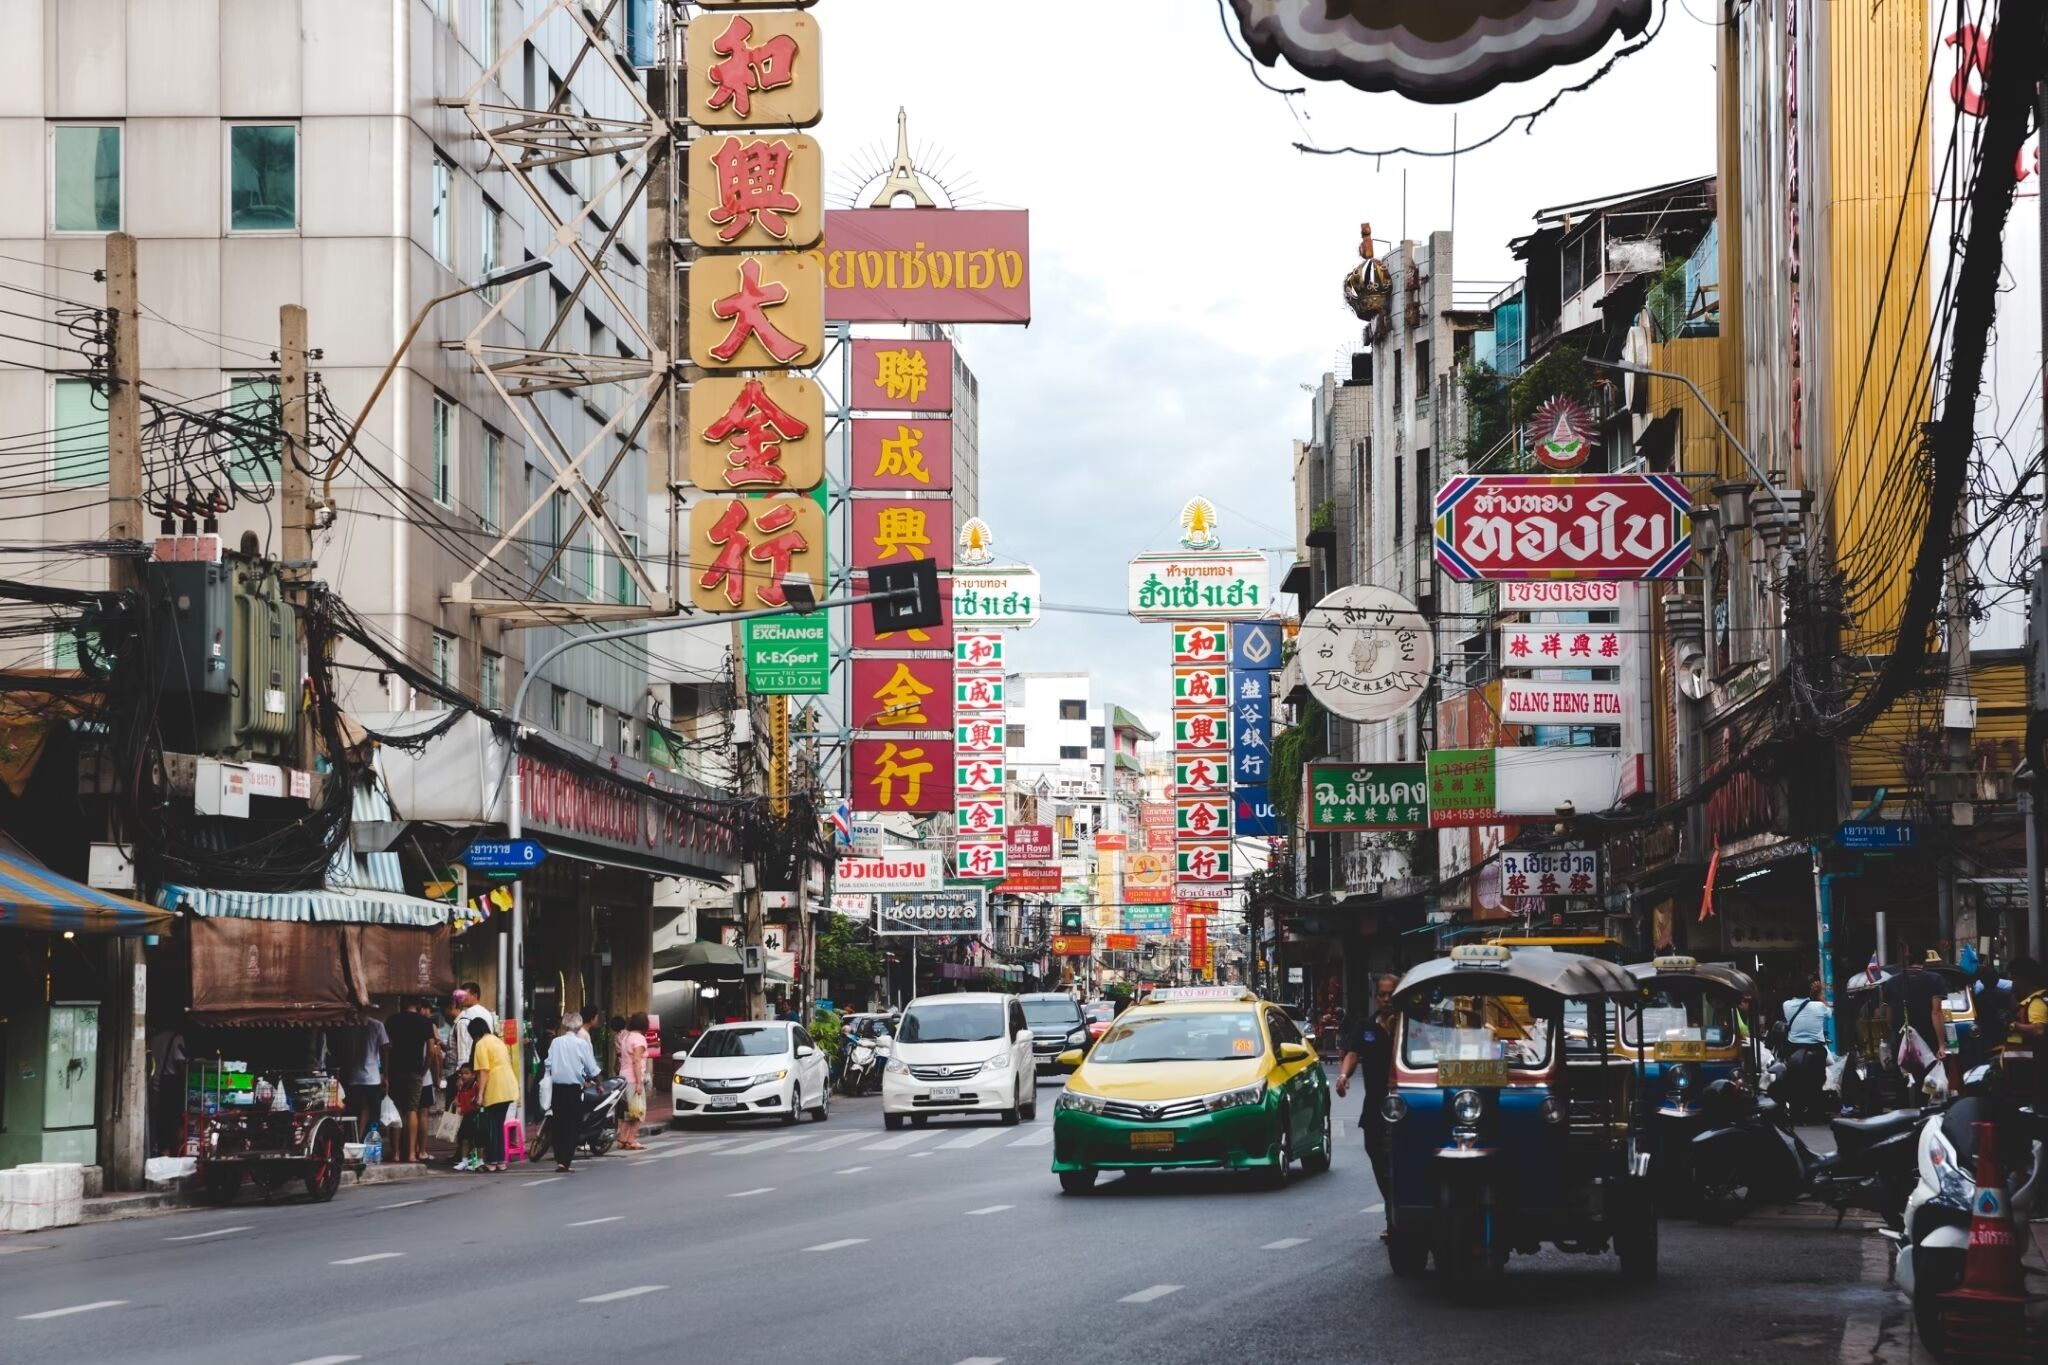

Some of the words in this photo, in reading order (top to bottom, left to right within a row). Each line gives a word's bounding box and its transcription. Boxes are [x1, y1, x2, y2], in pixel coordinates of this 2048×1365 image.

[1461, 492, 1665, 562] ทองใบ
[870, 348, 934, 806] 聯成興金行
[752, 628, 824, 640] EXCHANGE
[755, 646, 819, 667] K-Expert
[755, 675, 822, 686] WISDOM
[1509, 692, 1549, 712] SIANG
[1552, 693, 1589, 712] HENG
[1593, 694, 1621, 714] HUA
[1239, 677, 1264, 776] 盤谷銀行
[968, 641, 994, 872] 和成興大金行
[1186, 627, 1218, 878] 和成興大金行
[1896, 827, 1911, 841] 11
[523, 845, 534, 860] 6
[1026, 844, 1050, 853] Royal
[1463, 947, 1499, 956] TAXI
